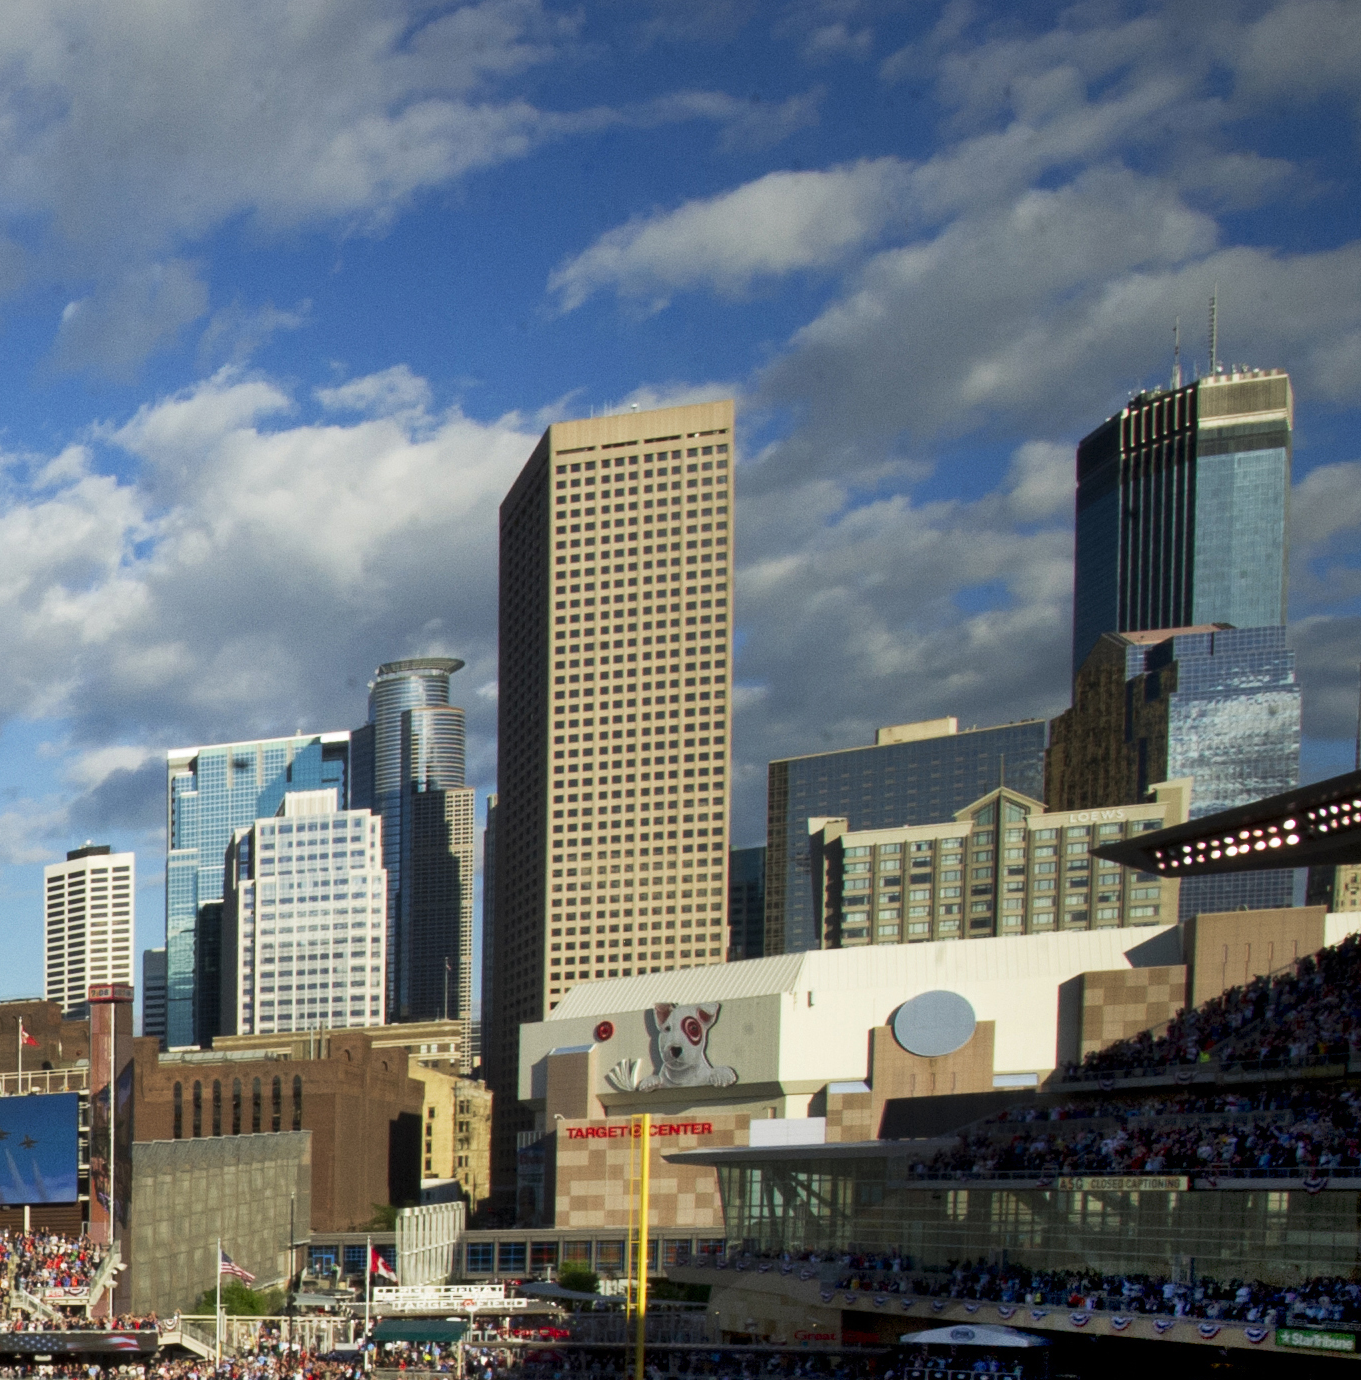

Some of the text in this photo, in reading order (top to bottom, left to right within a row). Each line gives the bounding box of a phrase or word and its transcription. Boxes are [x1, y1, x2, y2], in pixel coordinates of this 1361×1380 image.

[1070, 809, 1124, 823] LOEWS
[566, 1123, 713, 1139] TARGET CENTER
[1091, 1178, 1124, 1189] CLOSED
[1126, 1178, 1181, 1190] CAPTIONING
[1290, 1331, 1355, 1349] StarTribune
